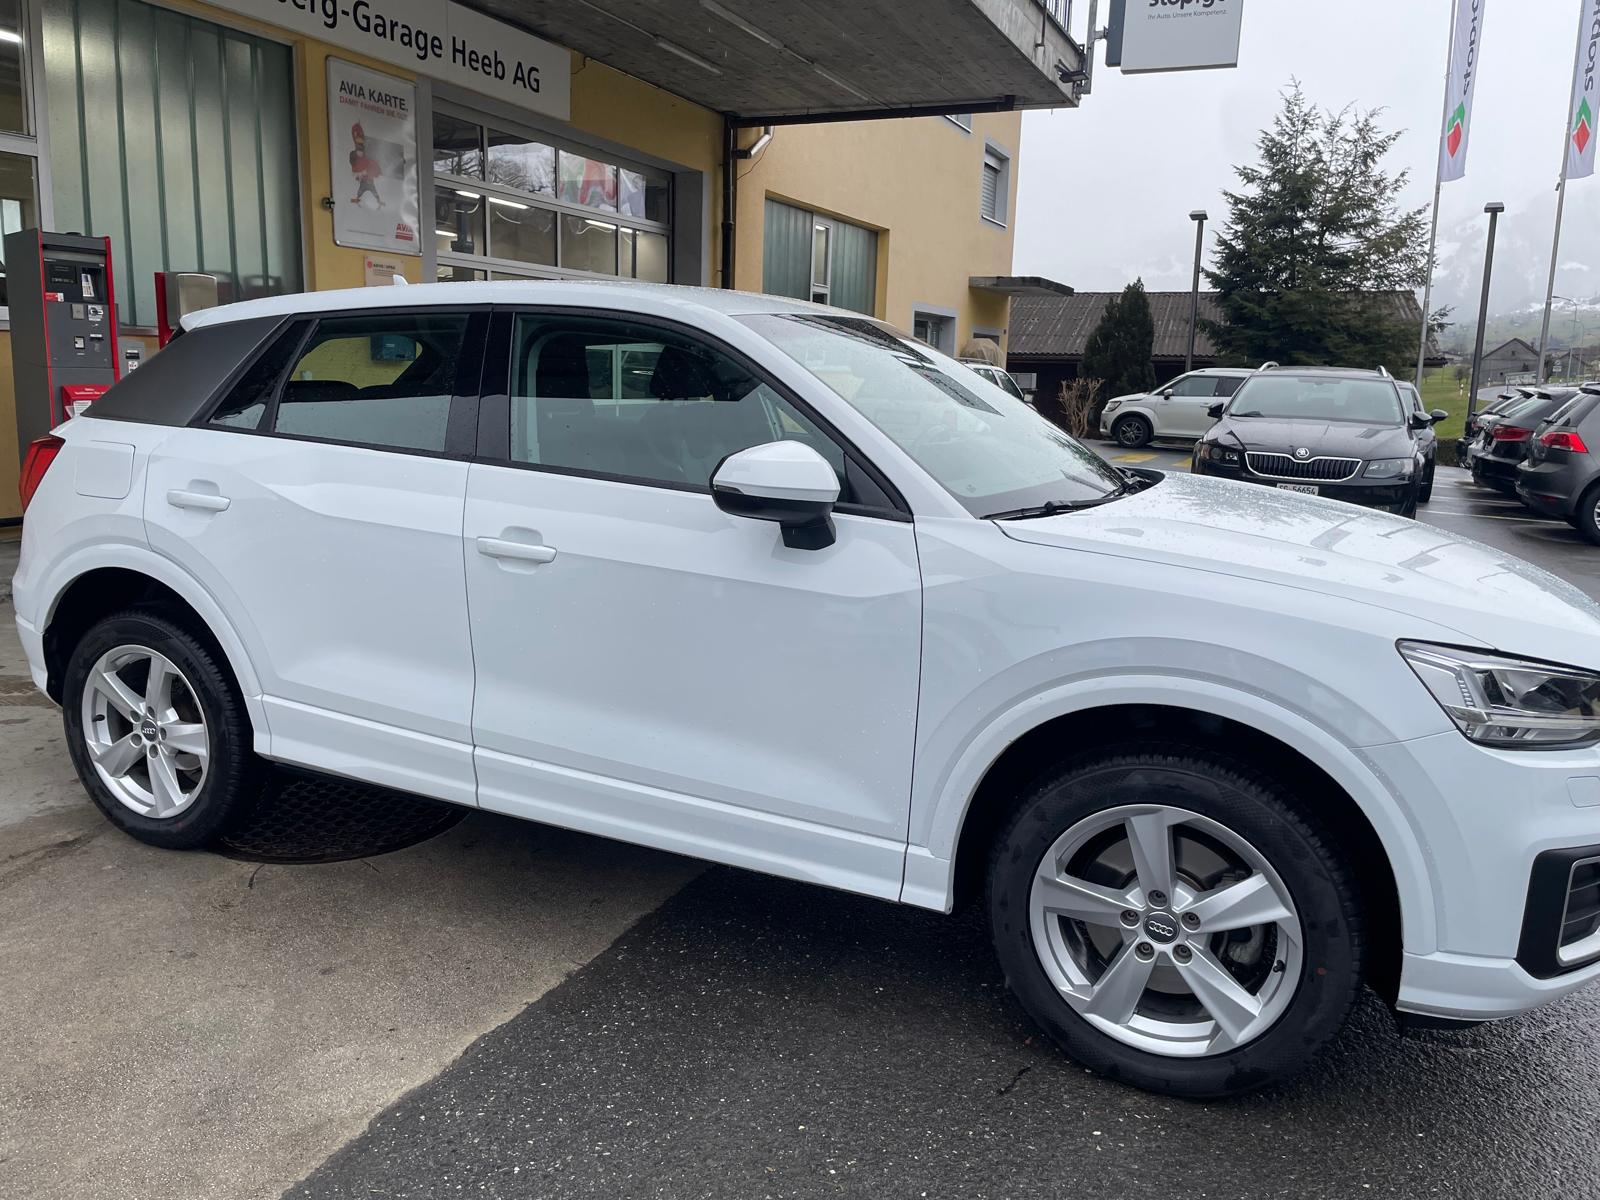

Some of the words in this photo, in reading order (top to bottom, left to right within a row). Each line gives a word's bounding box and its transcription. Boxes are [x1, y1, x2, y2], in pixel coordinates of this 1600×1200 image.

[452, 36, 506, 80] Heeb
[512, 61, 541, 93] AG
[339, 80, 366, 99] AVIA
[368, 89, 409, 112] KARTE.
